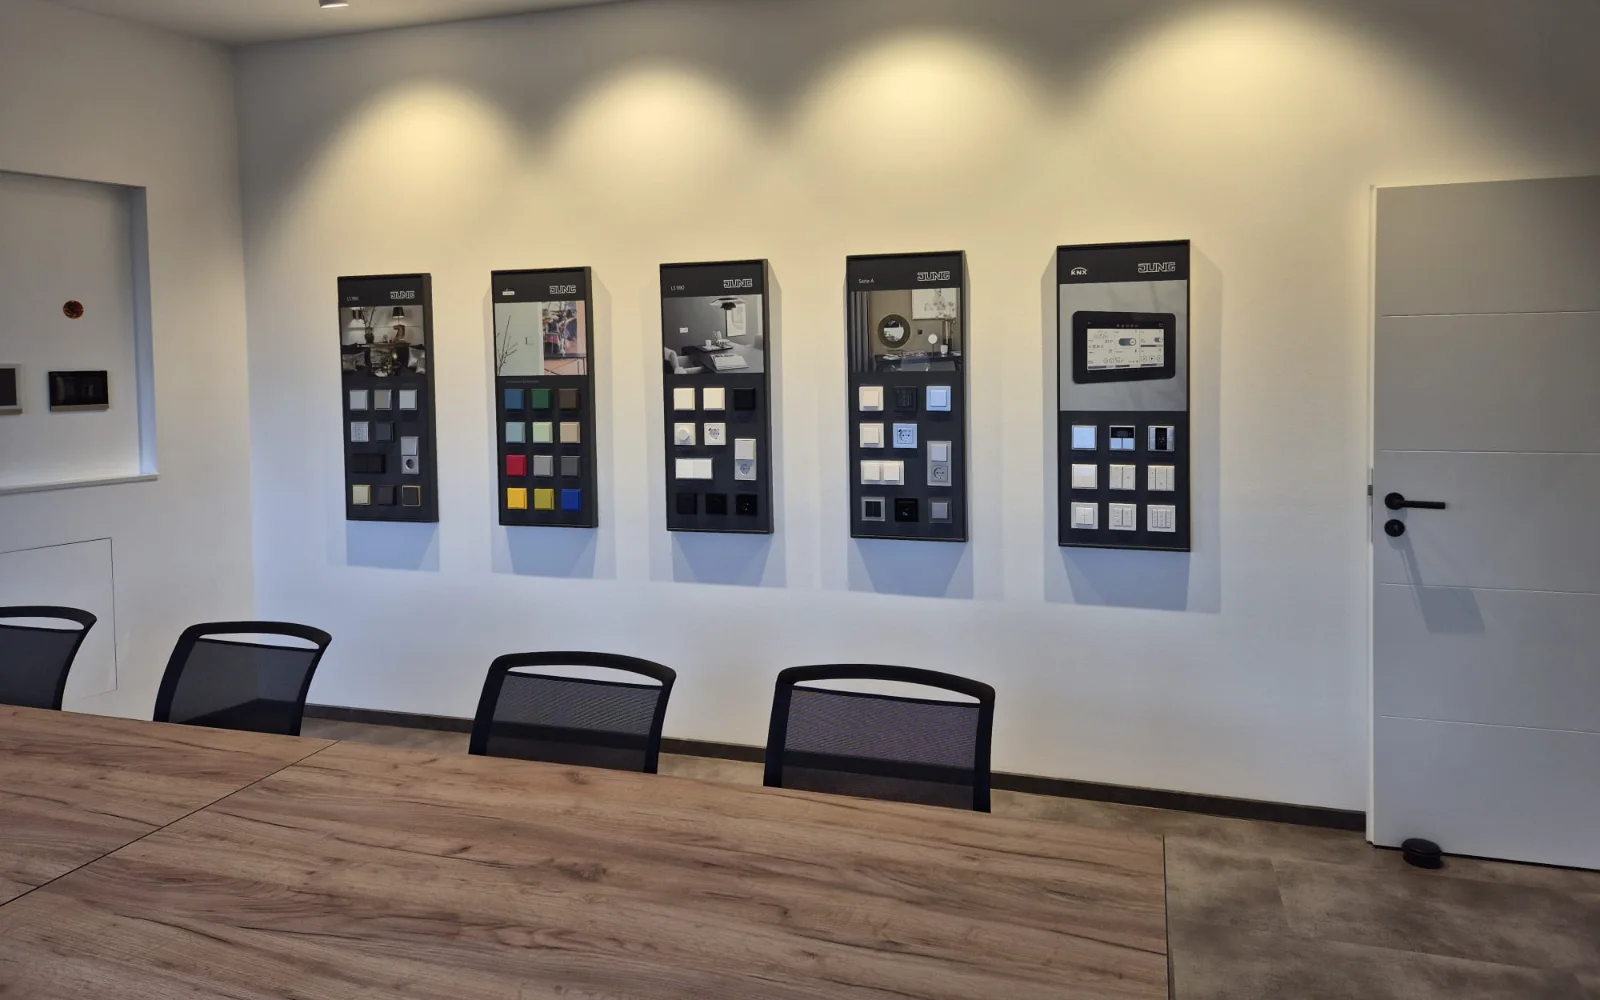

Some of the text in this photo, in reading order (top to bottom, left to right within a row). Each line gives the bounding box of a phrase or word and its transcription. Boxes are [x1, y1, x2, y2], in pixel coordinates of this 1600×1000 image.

[1138, 262, 1176, 274] JUNG
[917, 271, 951, 282] JUNG
[723, 278, 753, 288] JUNG
[549, 284, 576, 294] JUNG
[390, 290, 415, 300] JUNG
